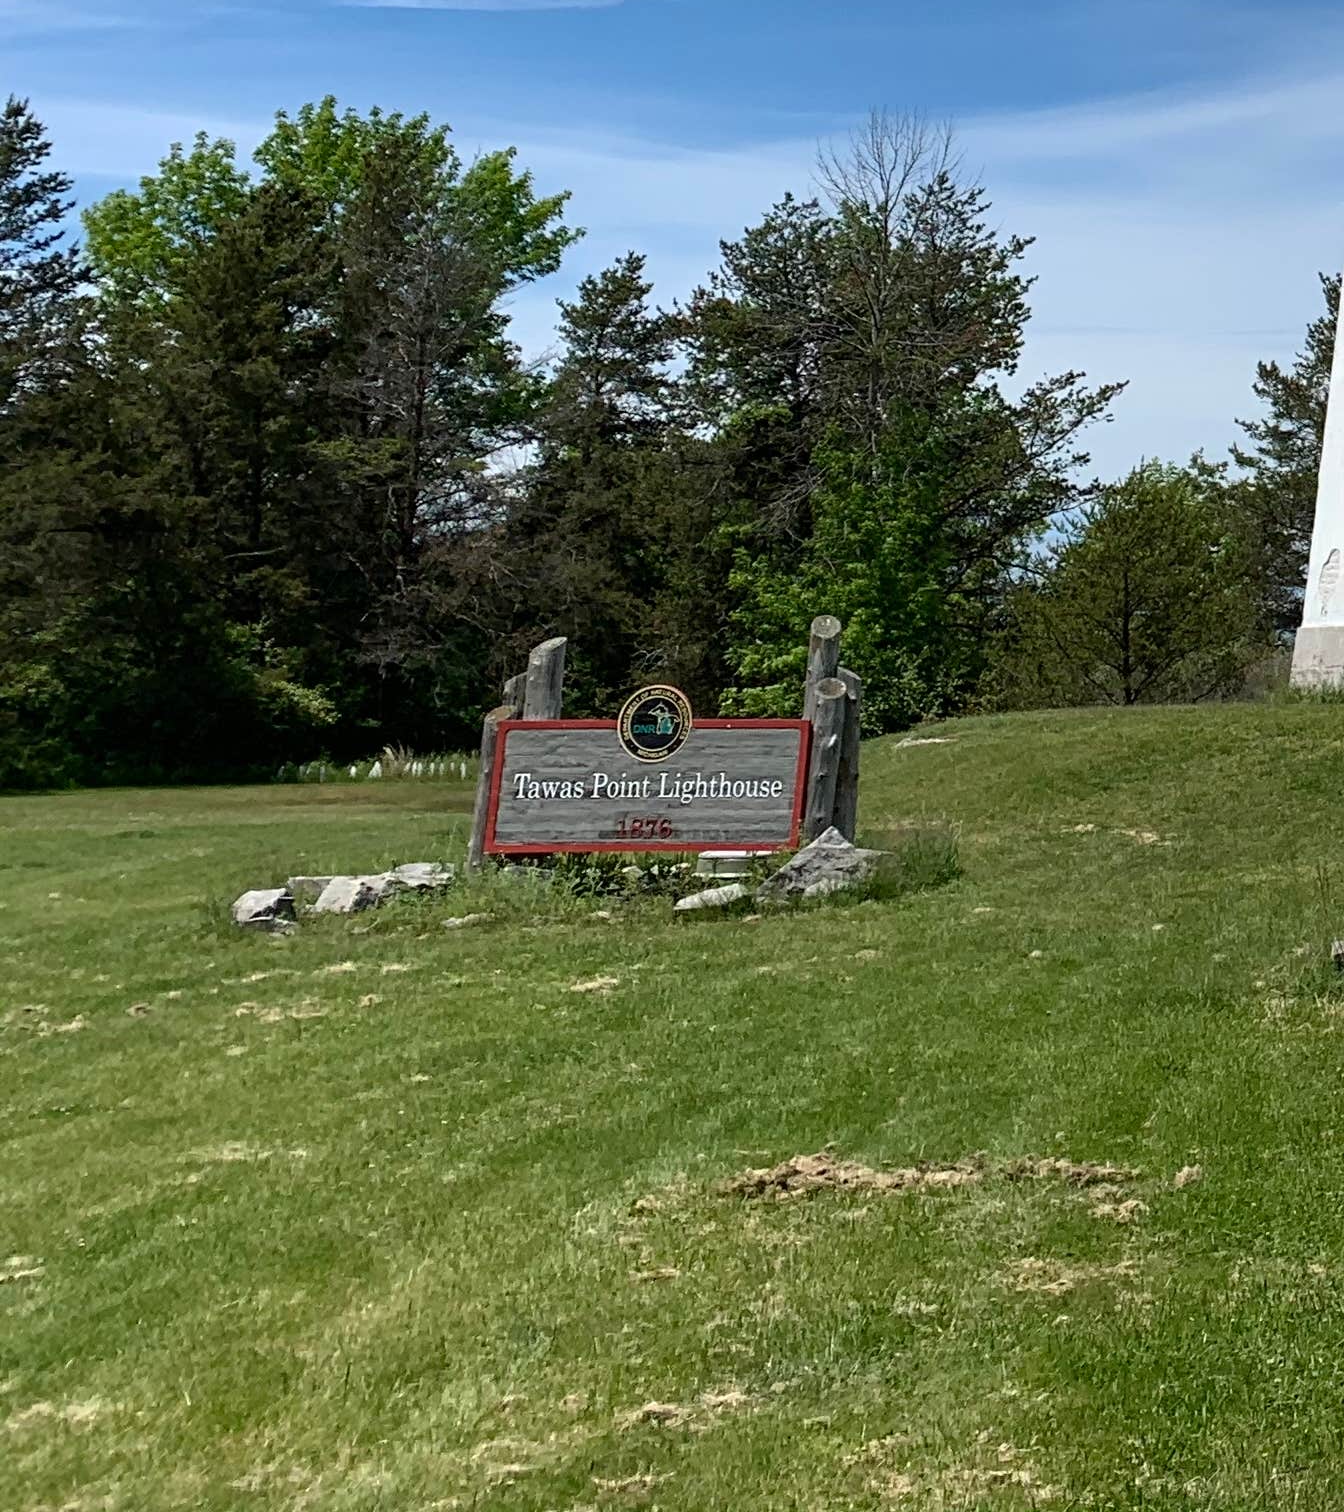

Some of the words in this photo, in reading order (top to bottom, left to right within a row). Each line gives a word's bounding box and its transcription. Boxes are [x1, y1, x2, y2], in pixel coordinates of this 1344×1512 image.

[632, 724, 656, 734] DNR
[513, 772, 585, 799] Tawas
[590, 772, 652, 798] Point
[658, 772, 783, 804] Lighthouse
[615, 818, 672, 839] 1876
